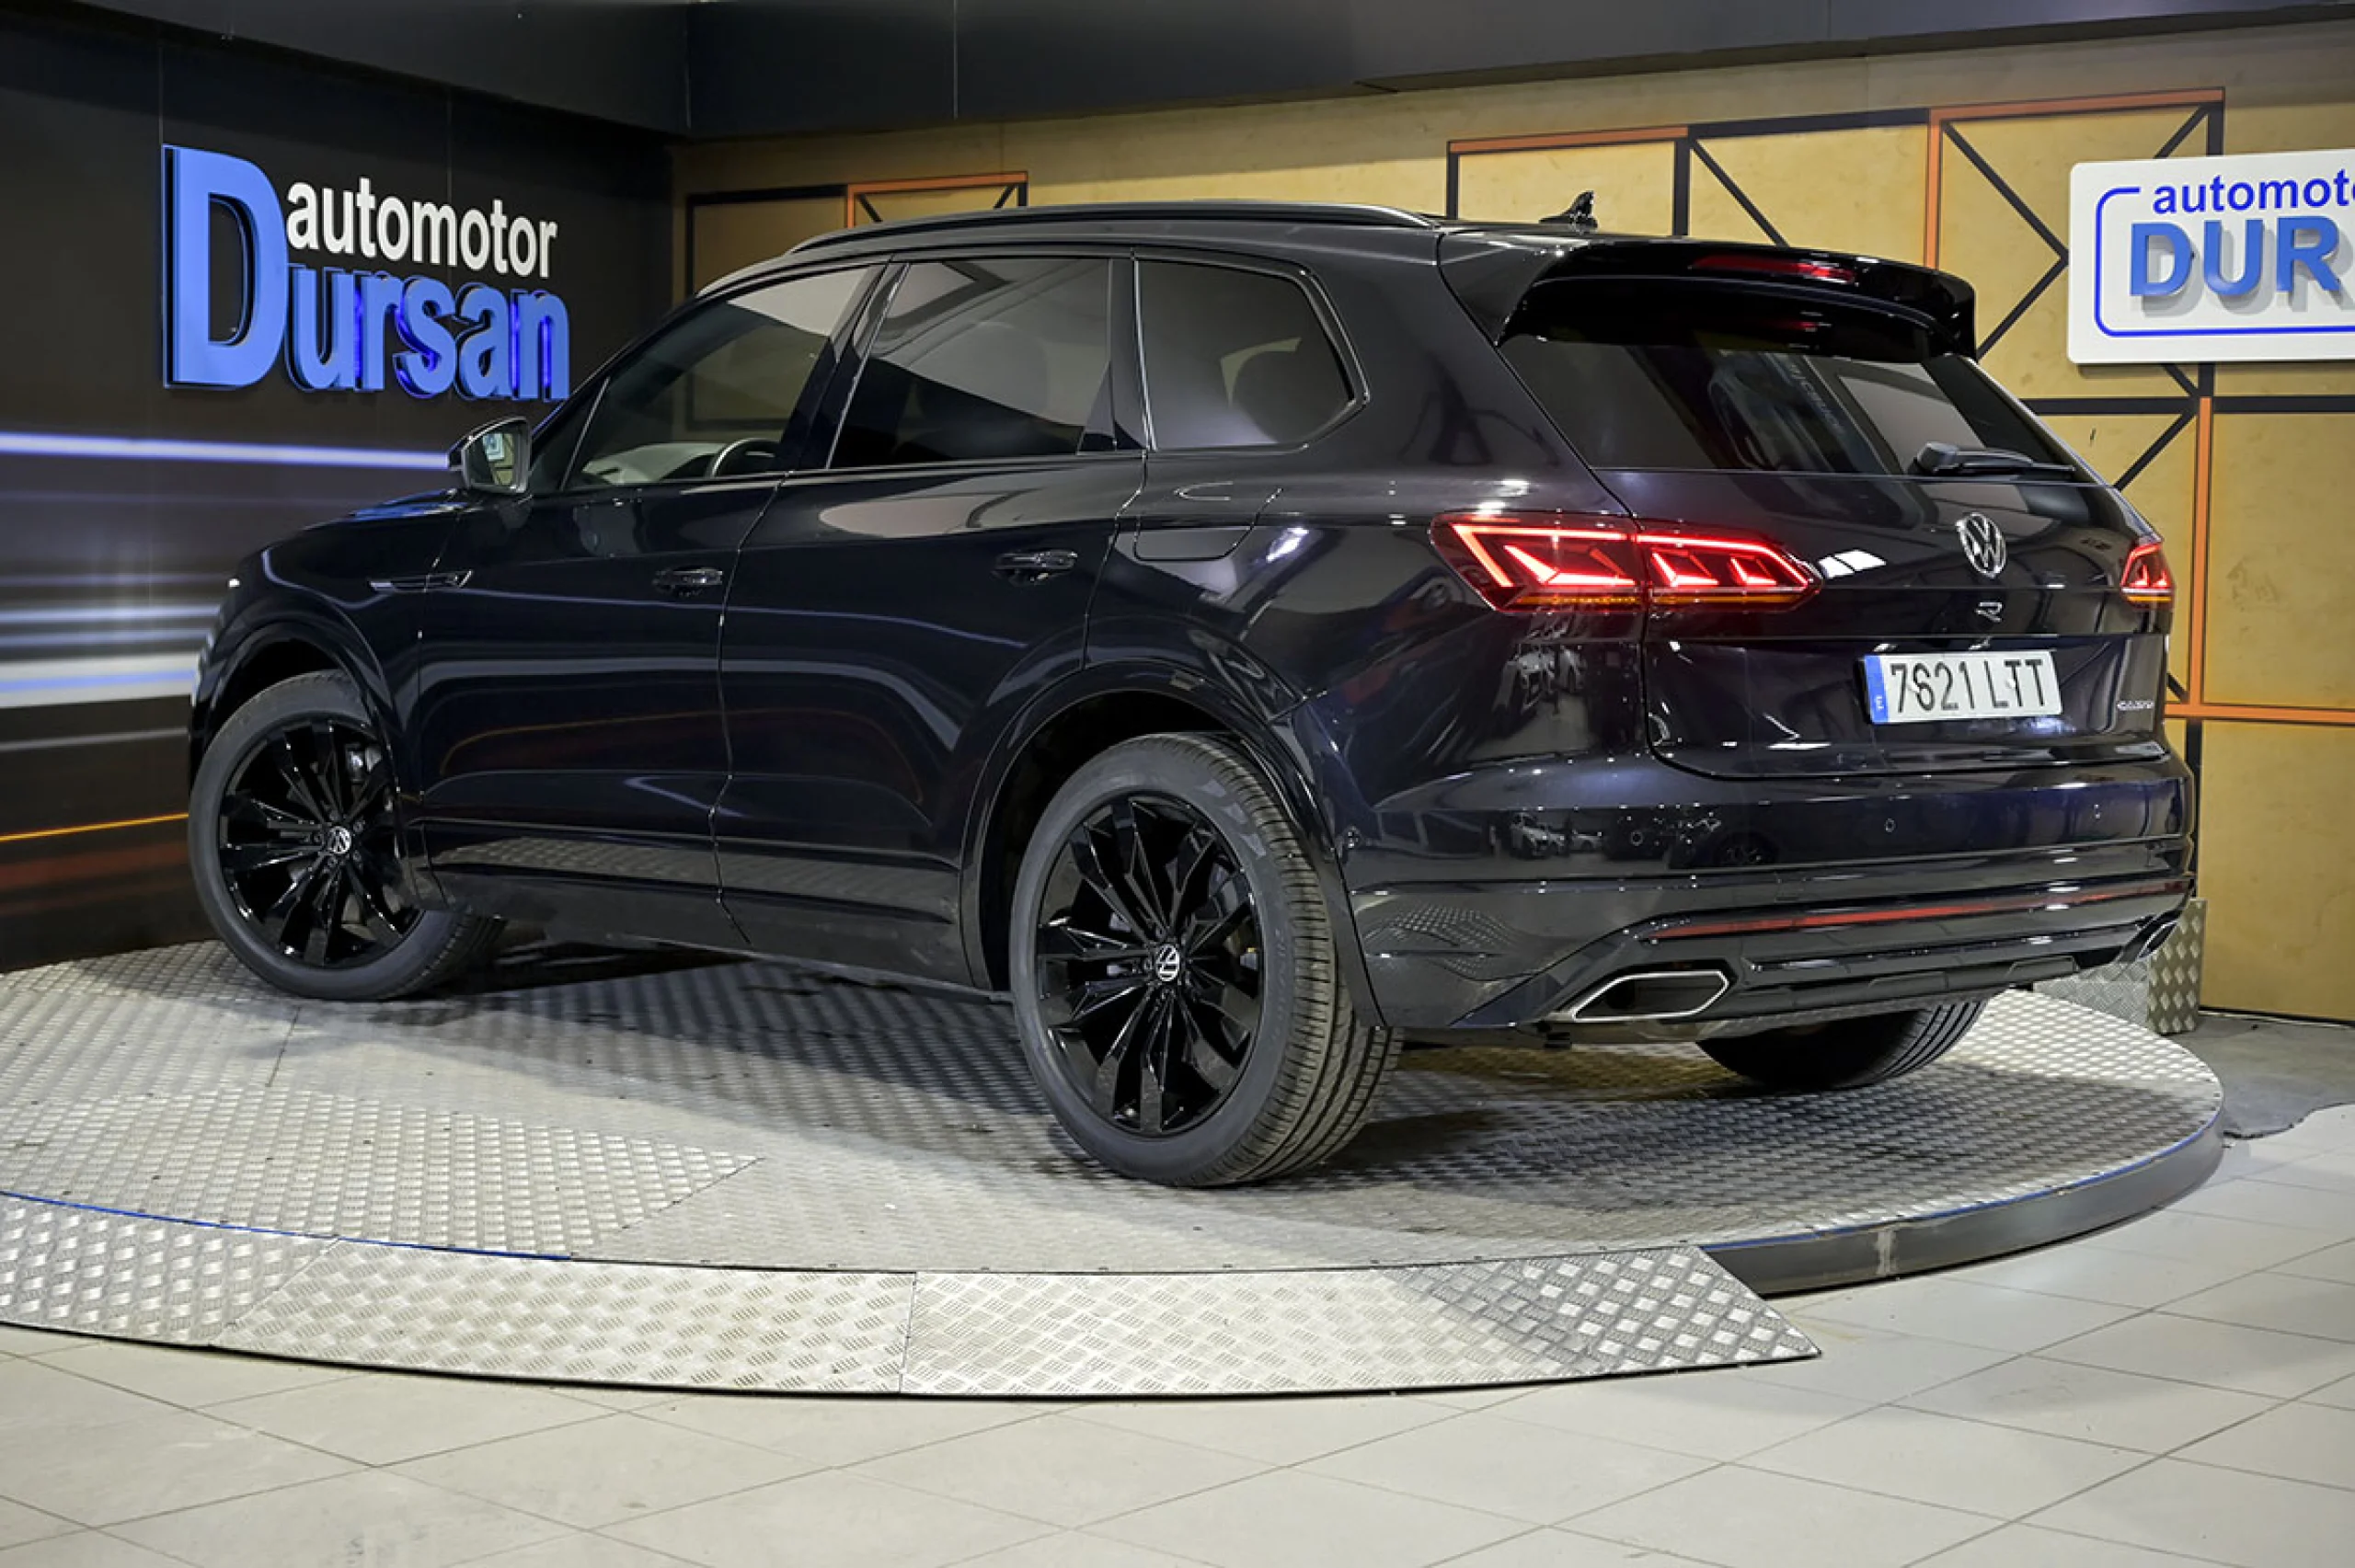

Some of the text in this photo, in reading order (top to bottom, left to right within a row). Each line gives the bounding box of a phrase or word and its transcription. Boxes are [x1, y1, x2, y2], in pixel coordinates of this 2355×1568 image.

[286, 177, 557, 278] automotor
[2152, 168, 2355, 214] automot
[163, 143, 569, 402] Dursan
[1891, 659, 2045, 713] 7621 LTT
